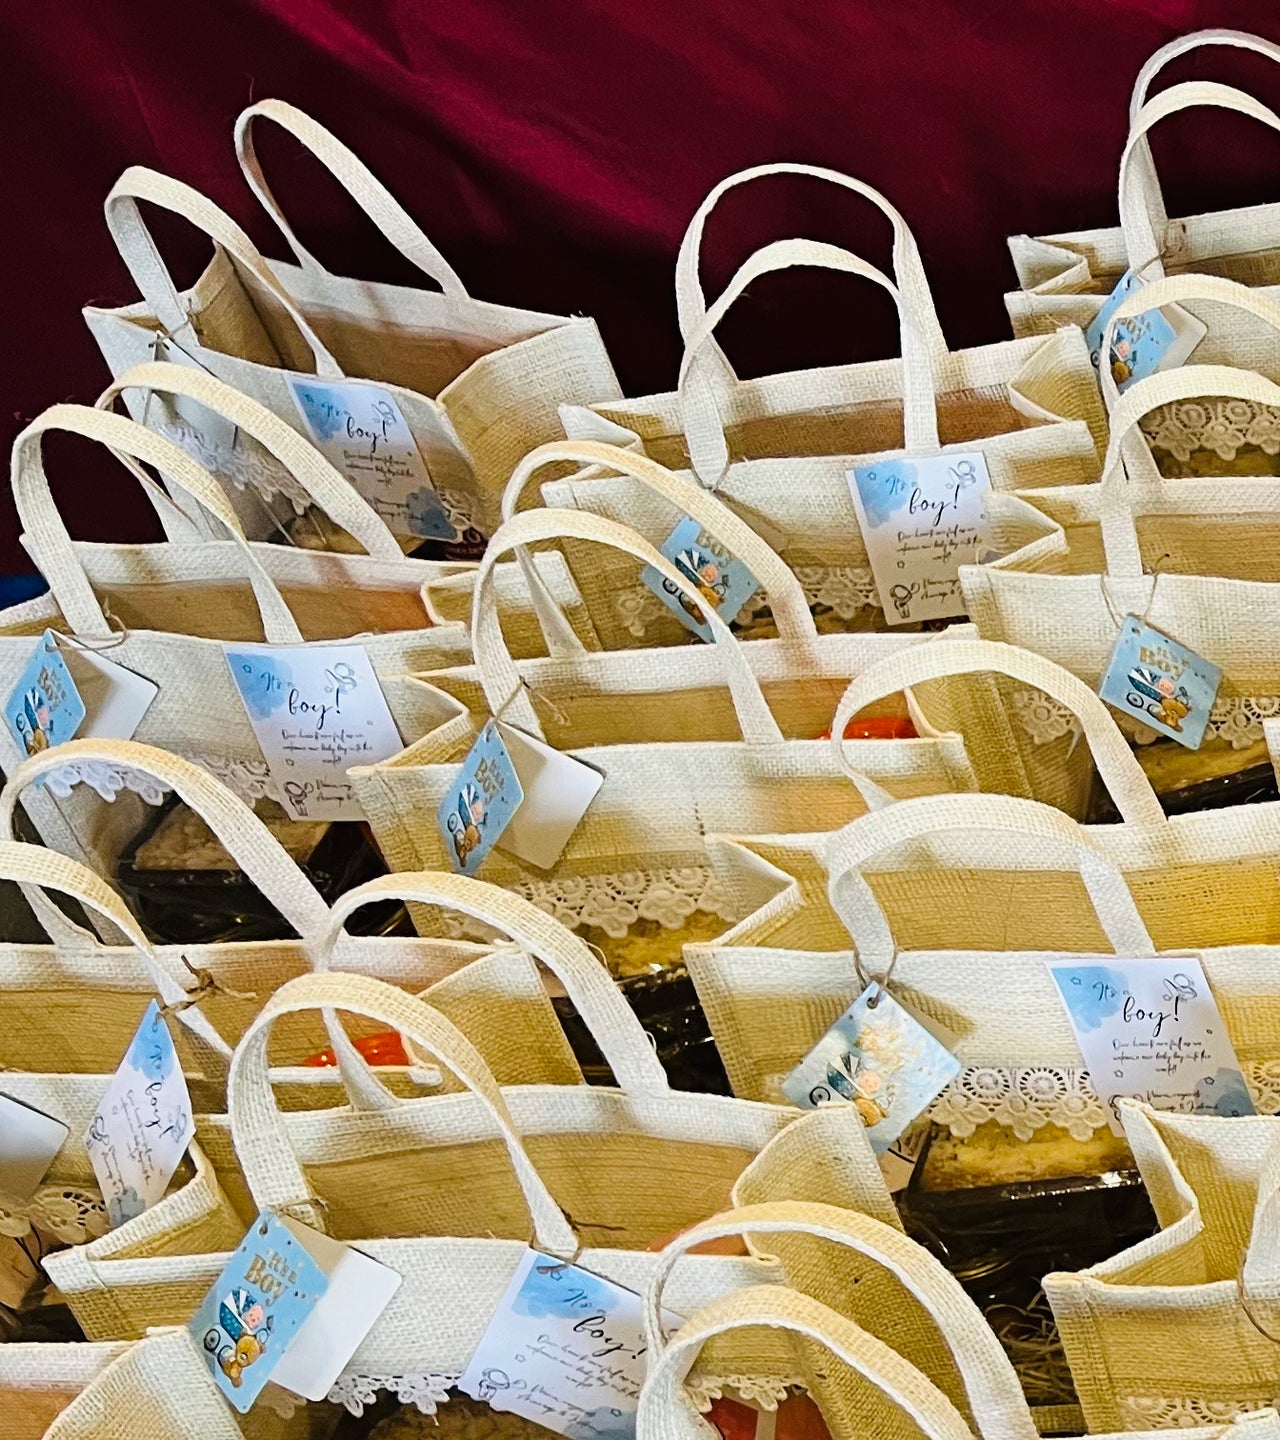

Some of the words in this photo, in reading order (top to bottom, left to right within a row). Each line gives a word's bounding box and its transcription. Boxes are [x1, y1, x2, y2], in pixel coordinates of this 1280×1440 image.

[909, 484, 960, 526] boy!
[289, 688, 341, 730] boy!
[1123, 996, 1180, 1037] boy!
[243, 1251, 290, 1308] Boy
